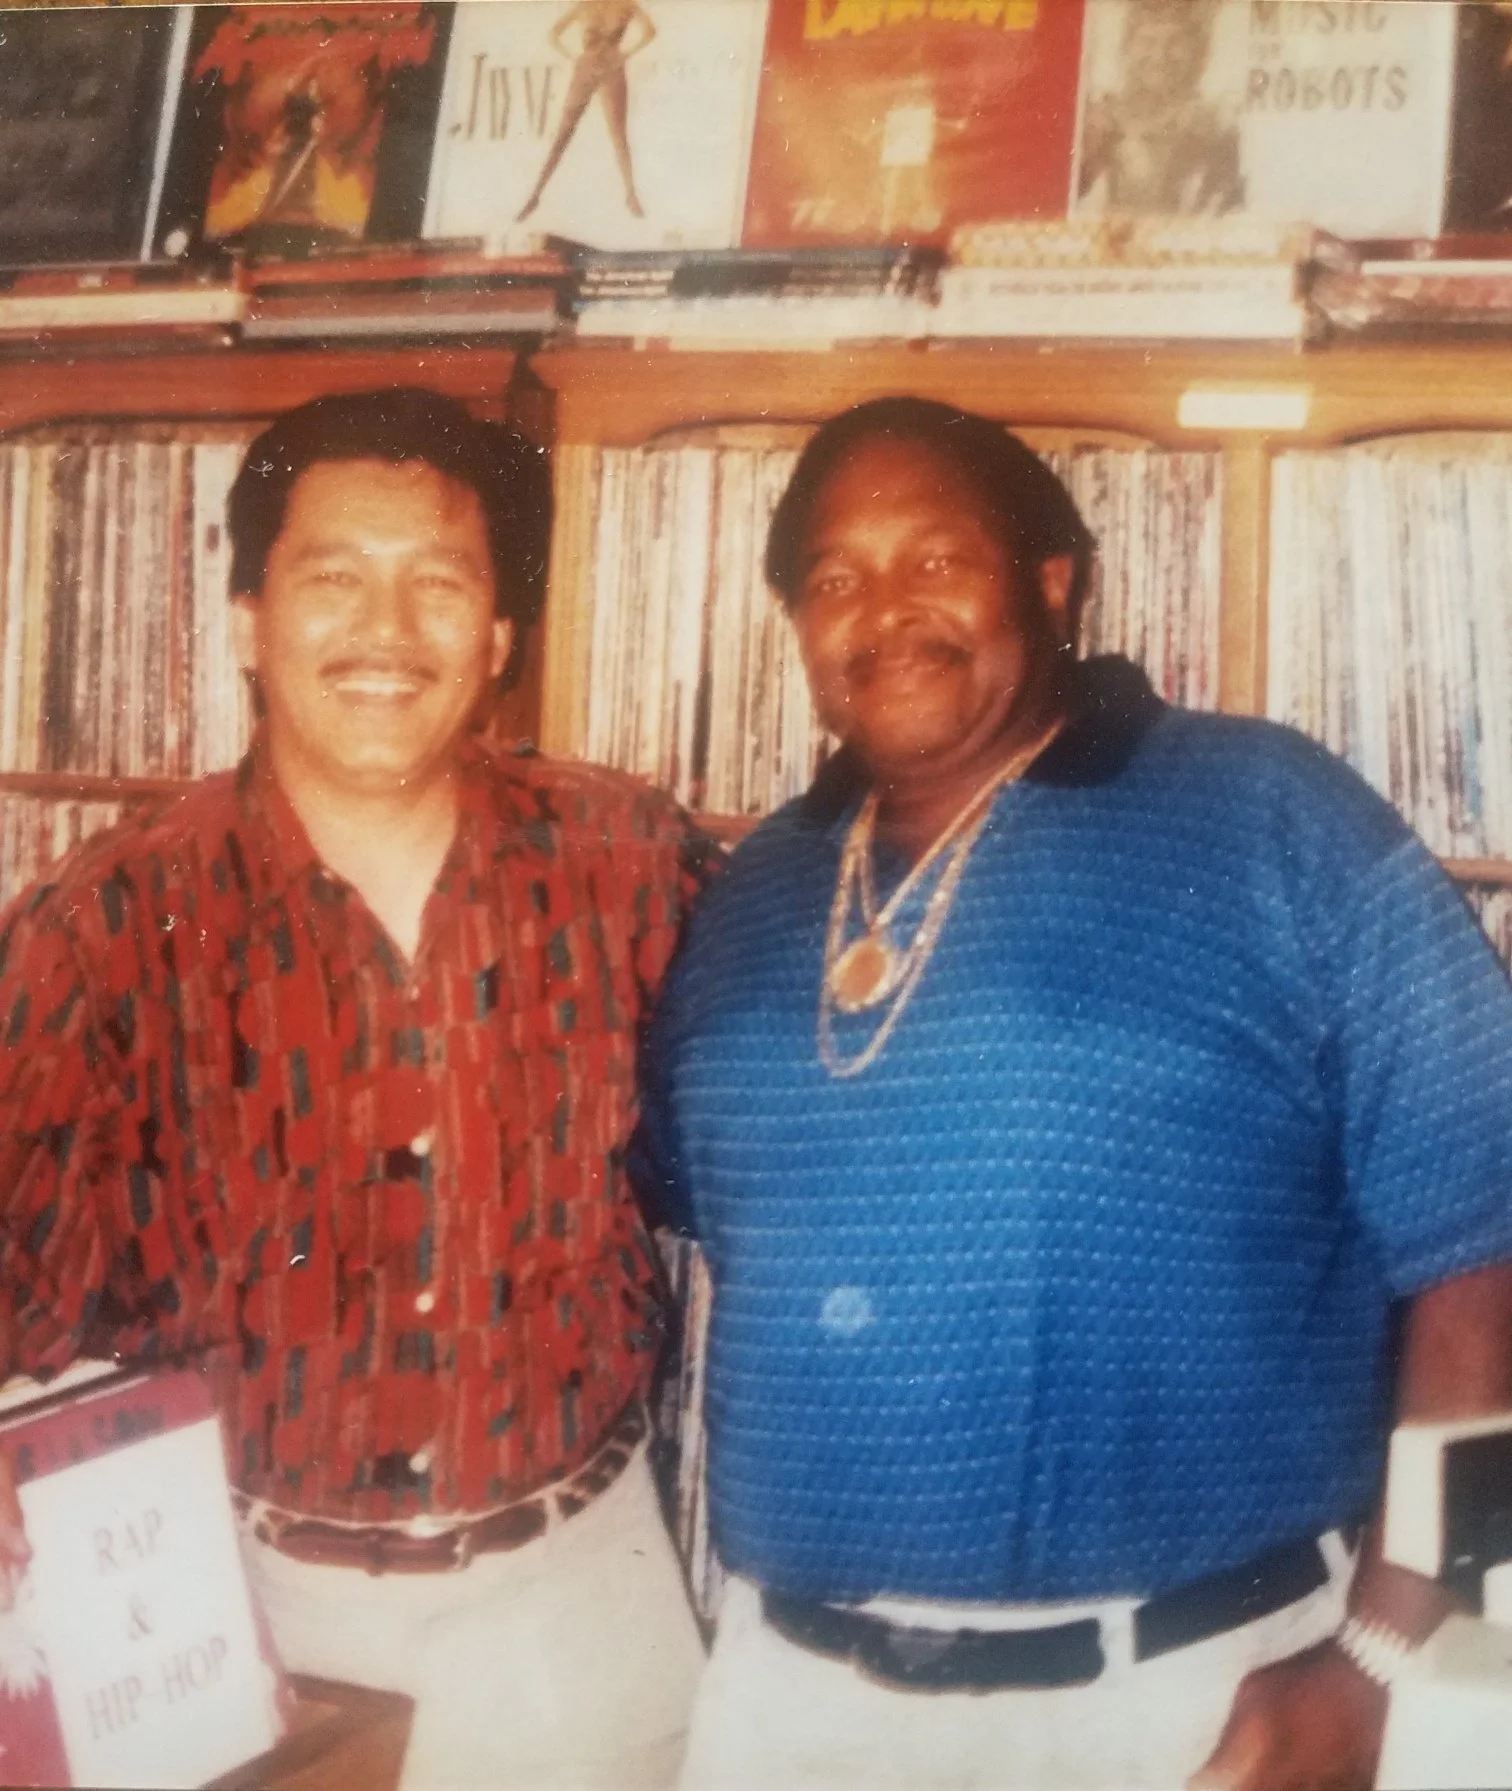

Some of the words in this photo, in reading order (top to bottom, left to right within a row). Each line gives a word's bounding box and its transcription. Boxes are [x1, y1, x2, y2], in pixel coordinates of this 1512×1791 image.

[1246, 65, 1409, 112] ROBOTS
[93, 1508, 164, 1577] RAP
[126, 1593, 154, 1642] &
